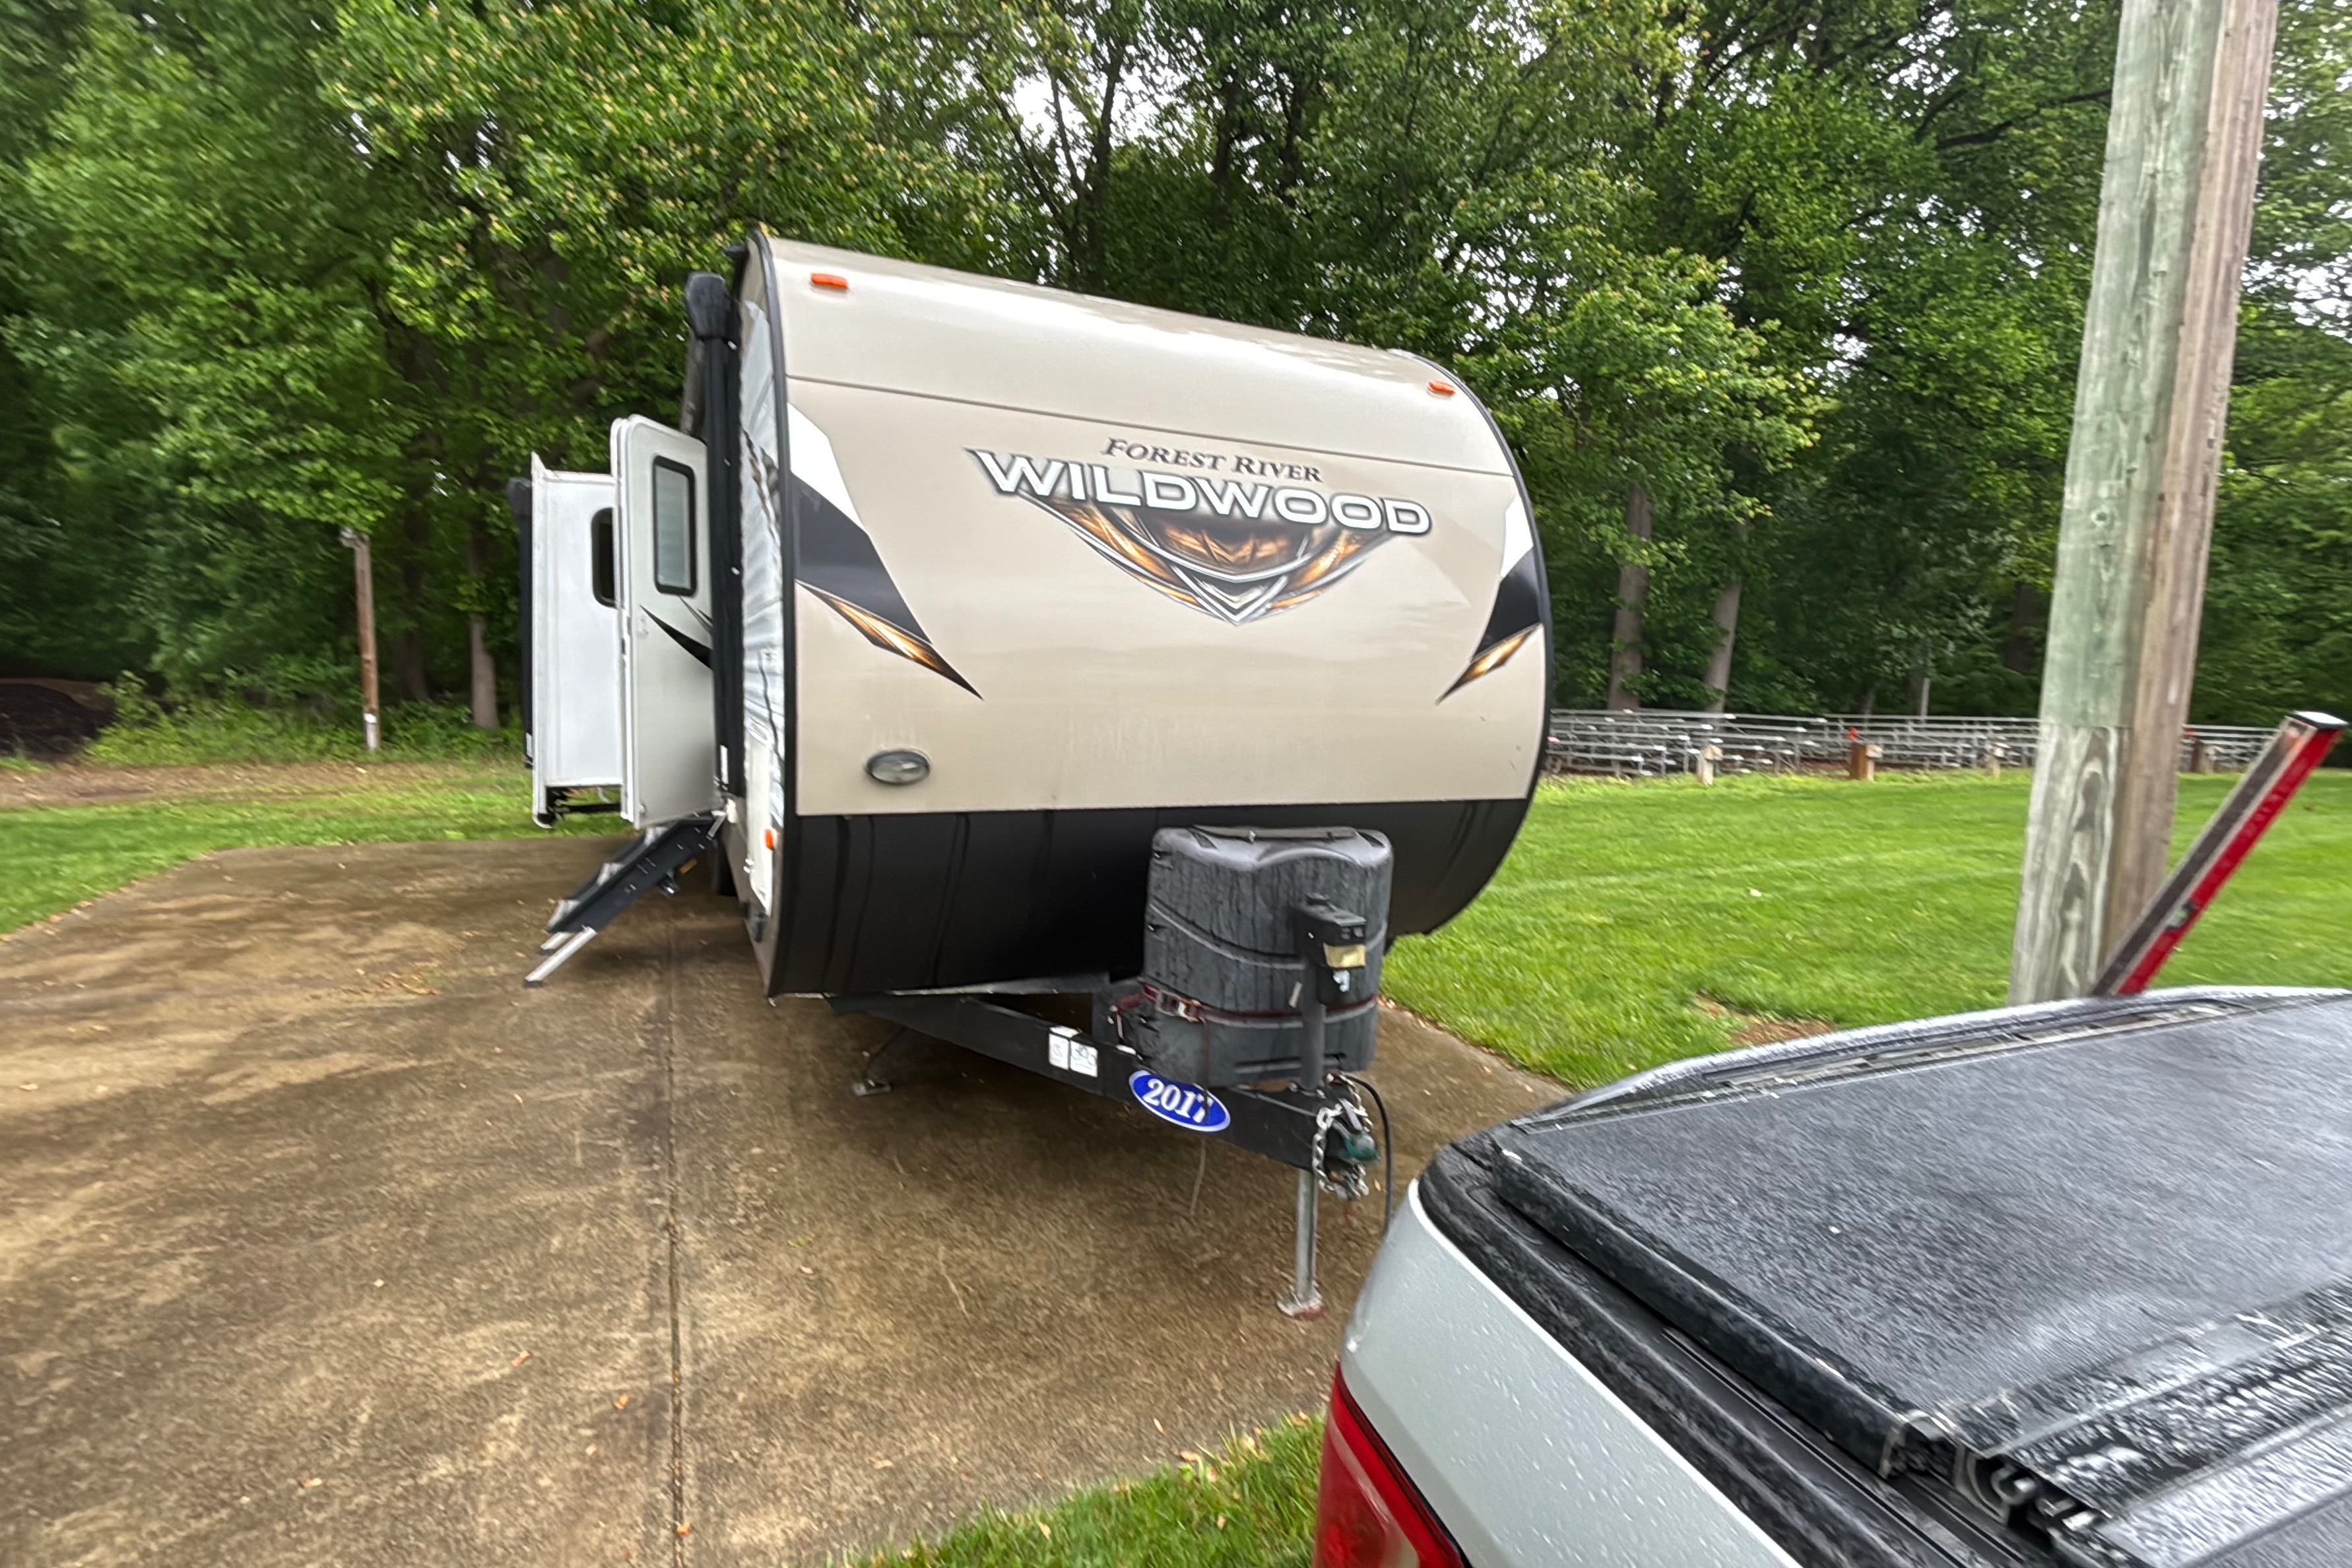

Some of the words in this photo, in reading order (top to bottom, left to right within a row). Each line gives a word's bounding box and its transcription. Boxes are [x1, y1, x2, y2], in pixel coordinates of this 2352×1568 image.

[1100, 436, 1225, 470] FOREST
[1233, 455, 1323, 483] RIVER
[964, 447, 1432, 536] WILDWOOD
[1142, 1078, 1214, 1123] 2017
